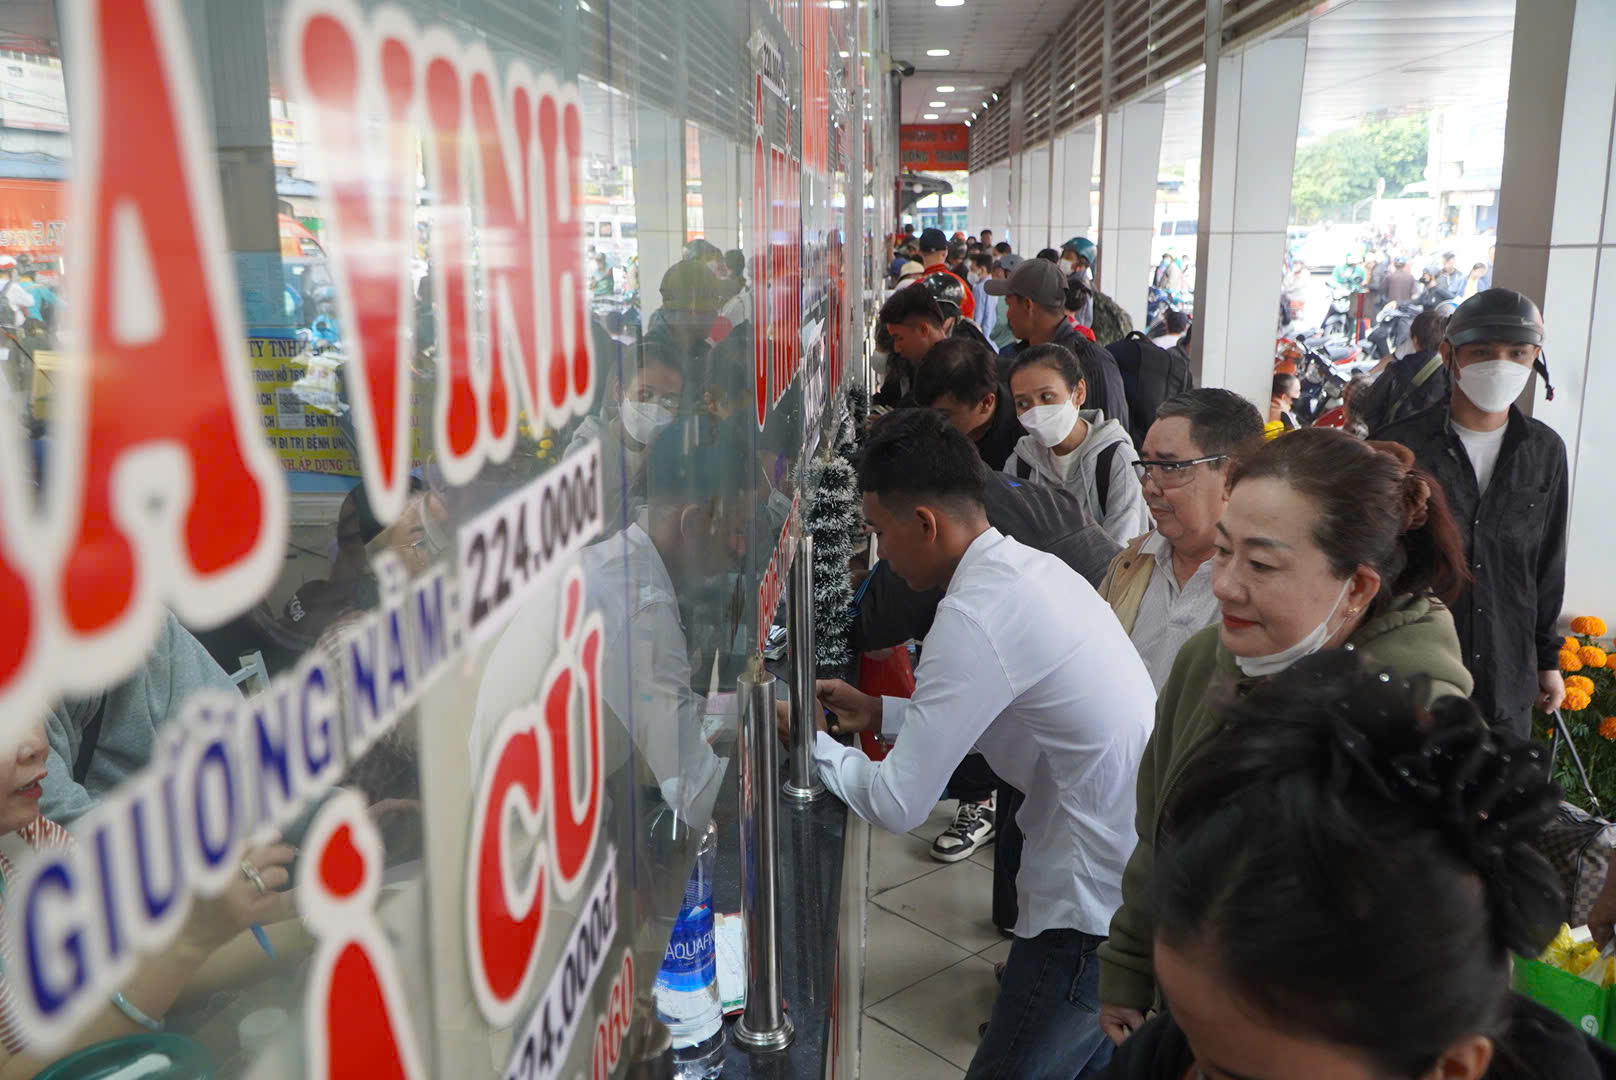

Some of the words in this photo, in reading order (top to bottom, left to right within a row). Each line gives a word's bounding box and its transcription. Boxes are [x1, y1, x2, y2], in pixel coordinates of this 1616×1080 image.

[302, 13, 590, 490] VINH
[22, 664, 332, 1017] GIƯỜNG
[468, 453, 598, 628] 224.000đ
[508, 870, 613, 1080] 24.000đ
